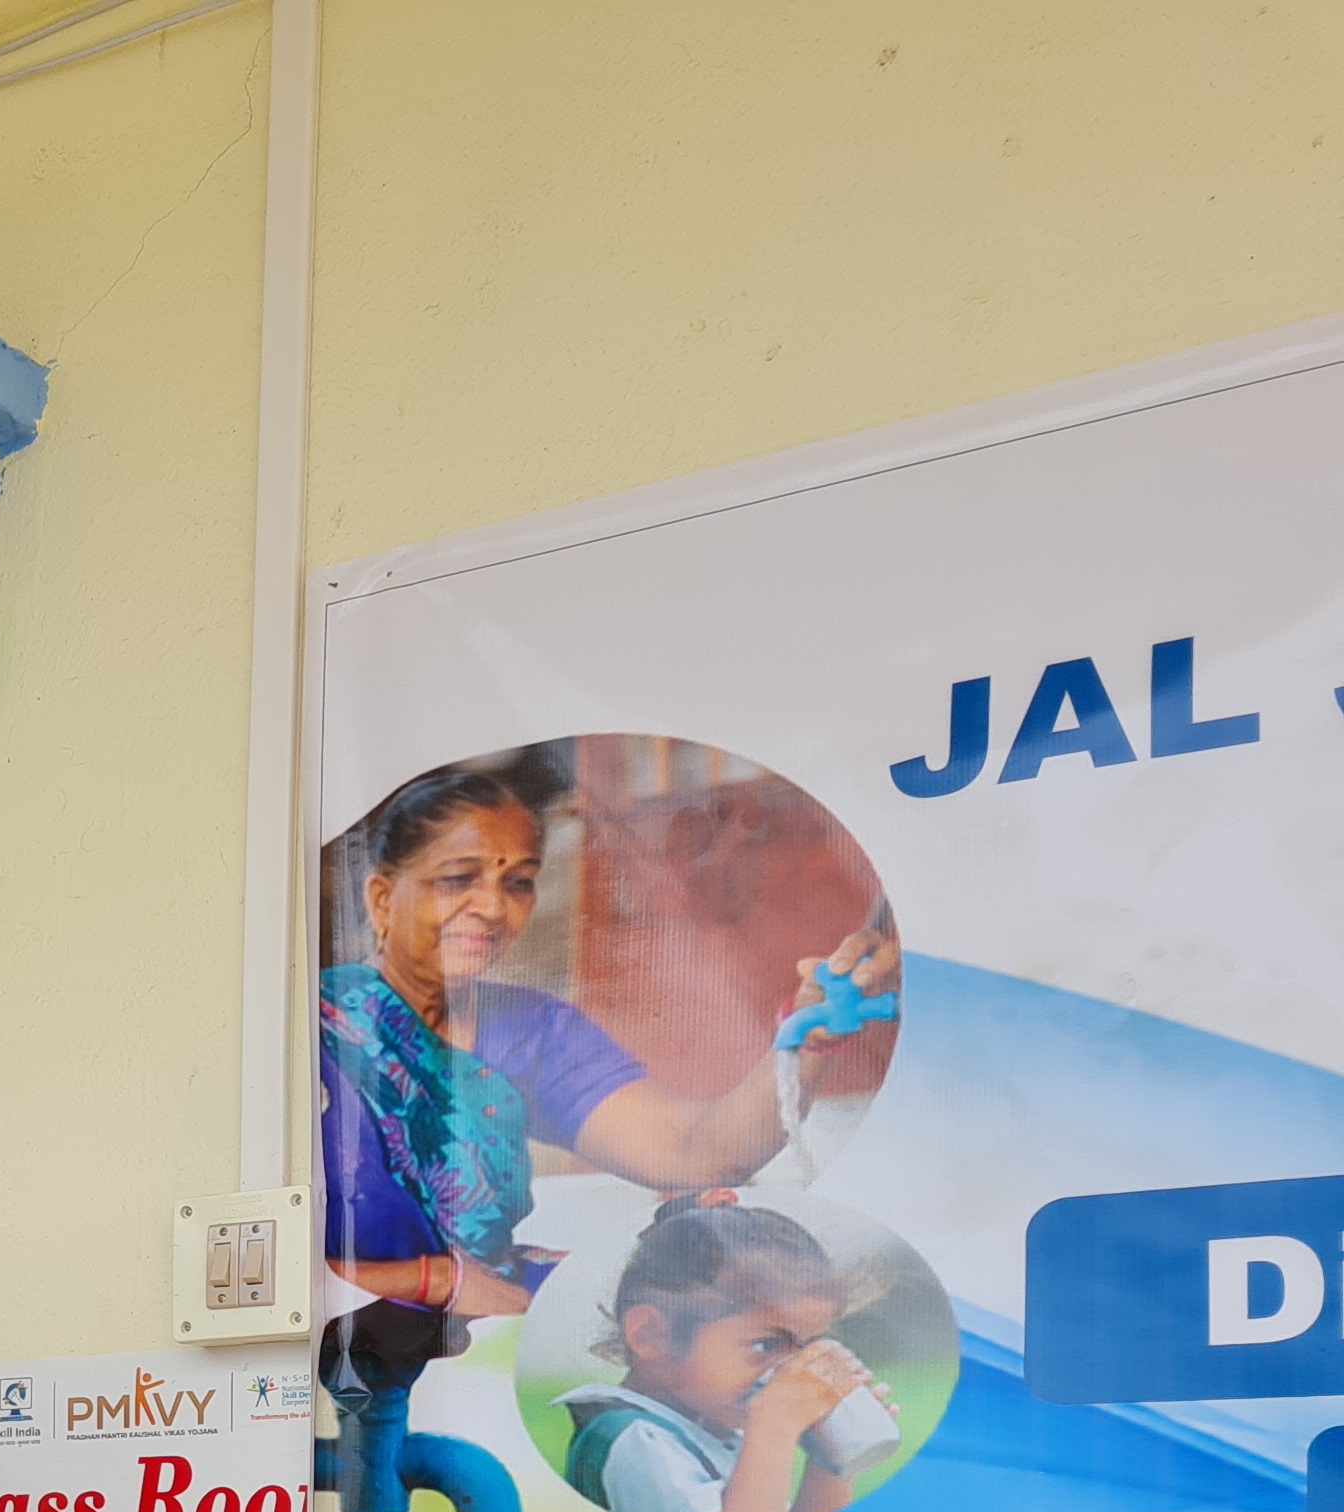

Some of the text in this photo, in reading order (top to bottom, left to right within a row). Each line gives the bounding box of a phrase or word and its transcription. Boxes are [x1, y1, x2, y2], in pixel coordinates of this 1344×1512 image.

[889, 636, 1260, 799] JAL
[67, 1367, 217, 1432] PMKVY
[15, 1427, 41, 1438] India
